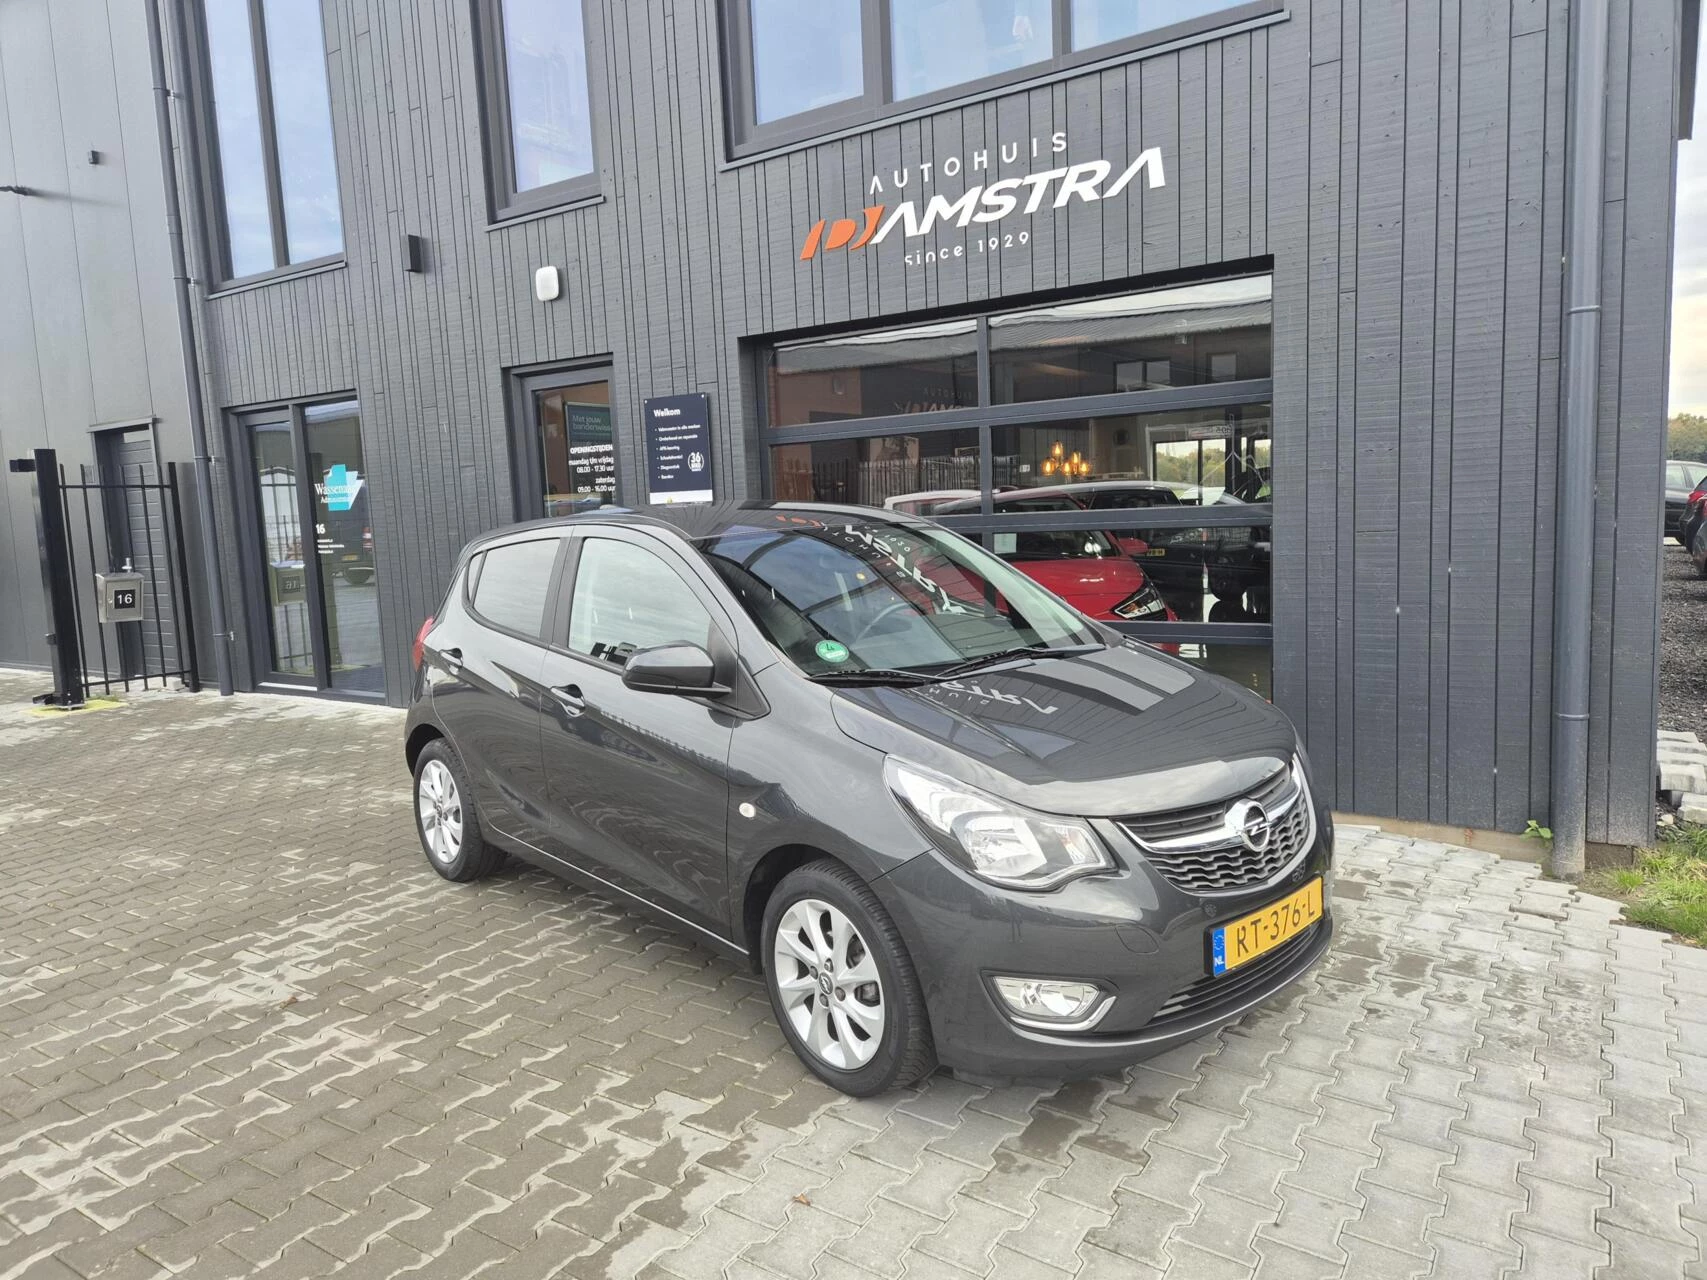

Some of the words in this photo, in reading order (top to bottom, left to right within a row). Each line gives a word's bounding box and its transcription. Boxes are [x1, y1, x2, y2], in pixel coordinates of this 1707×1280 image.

[869, 132, 1067, 195] AUTOHUIS
[904, 244, 963, 265] since
[977, 231, 1030, 254] 1929
[653, 408, 680, 417] Welkom
[570, 444, 613, 454] OPENINGSTIJDEN
[568, 457, 589, 466] maandag
[691, 452, 701, 462] 36
[595, 476, 615, 484] zaterdag
[315, 523, 326, 534] 16
[117, 593, 133, 604] 16
[1236, 891, 1315, 957] RT-376-L
[1214, 955, 1224, 967] NL
